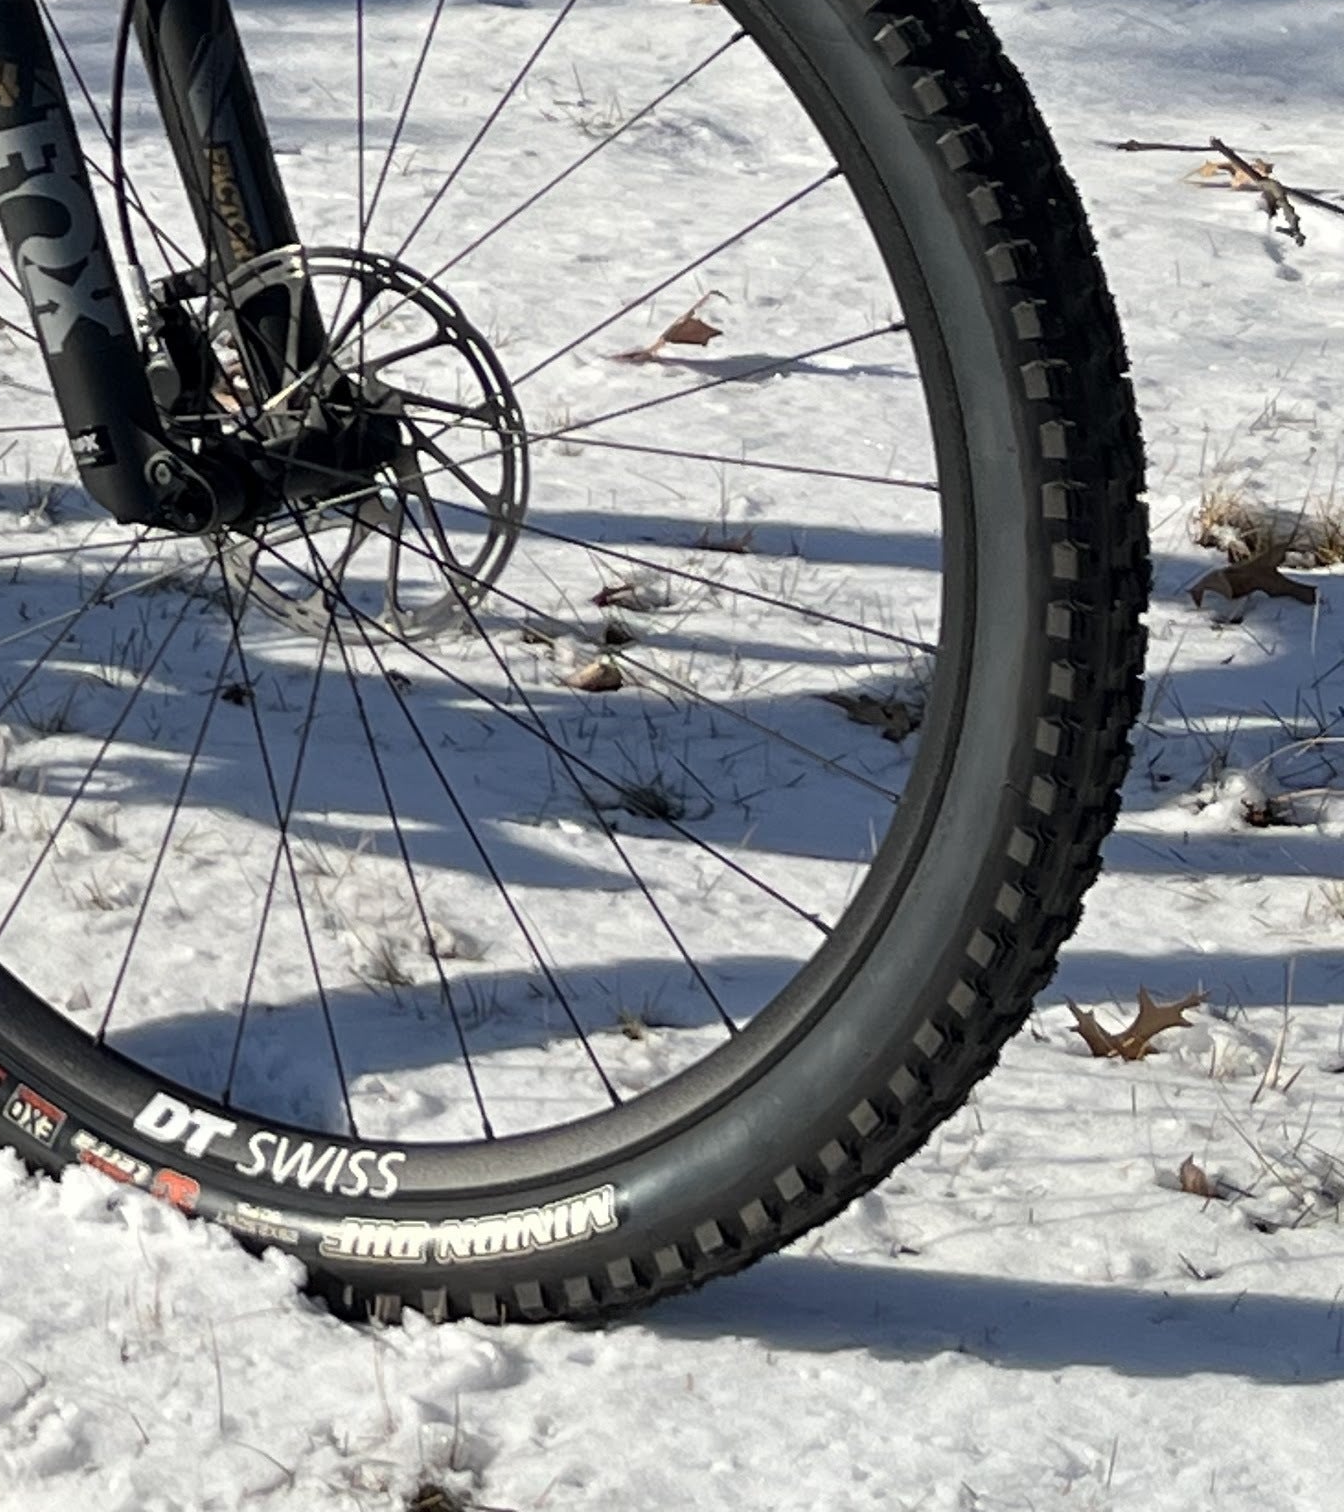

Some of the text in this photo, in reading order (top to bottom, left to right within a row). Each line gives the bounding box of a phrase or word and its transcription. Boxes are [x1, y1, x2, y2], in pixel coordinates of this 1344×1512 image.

[9, 1096, 57, 1145] EXO
[133, 1092, 238, 1158] DT
[236, 1130, 407, 1200] SWISS
[433, 1184, 617, 1264] MINION
